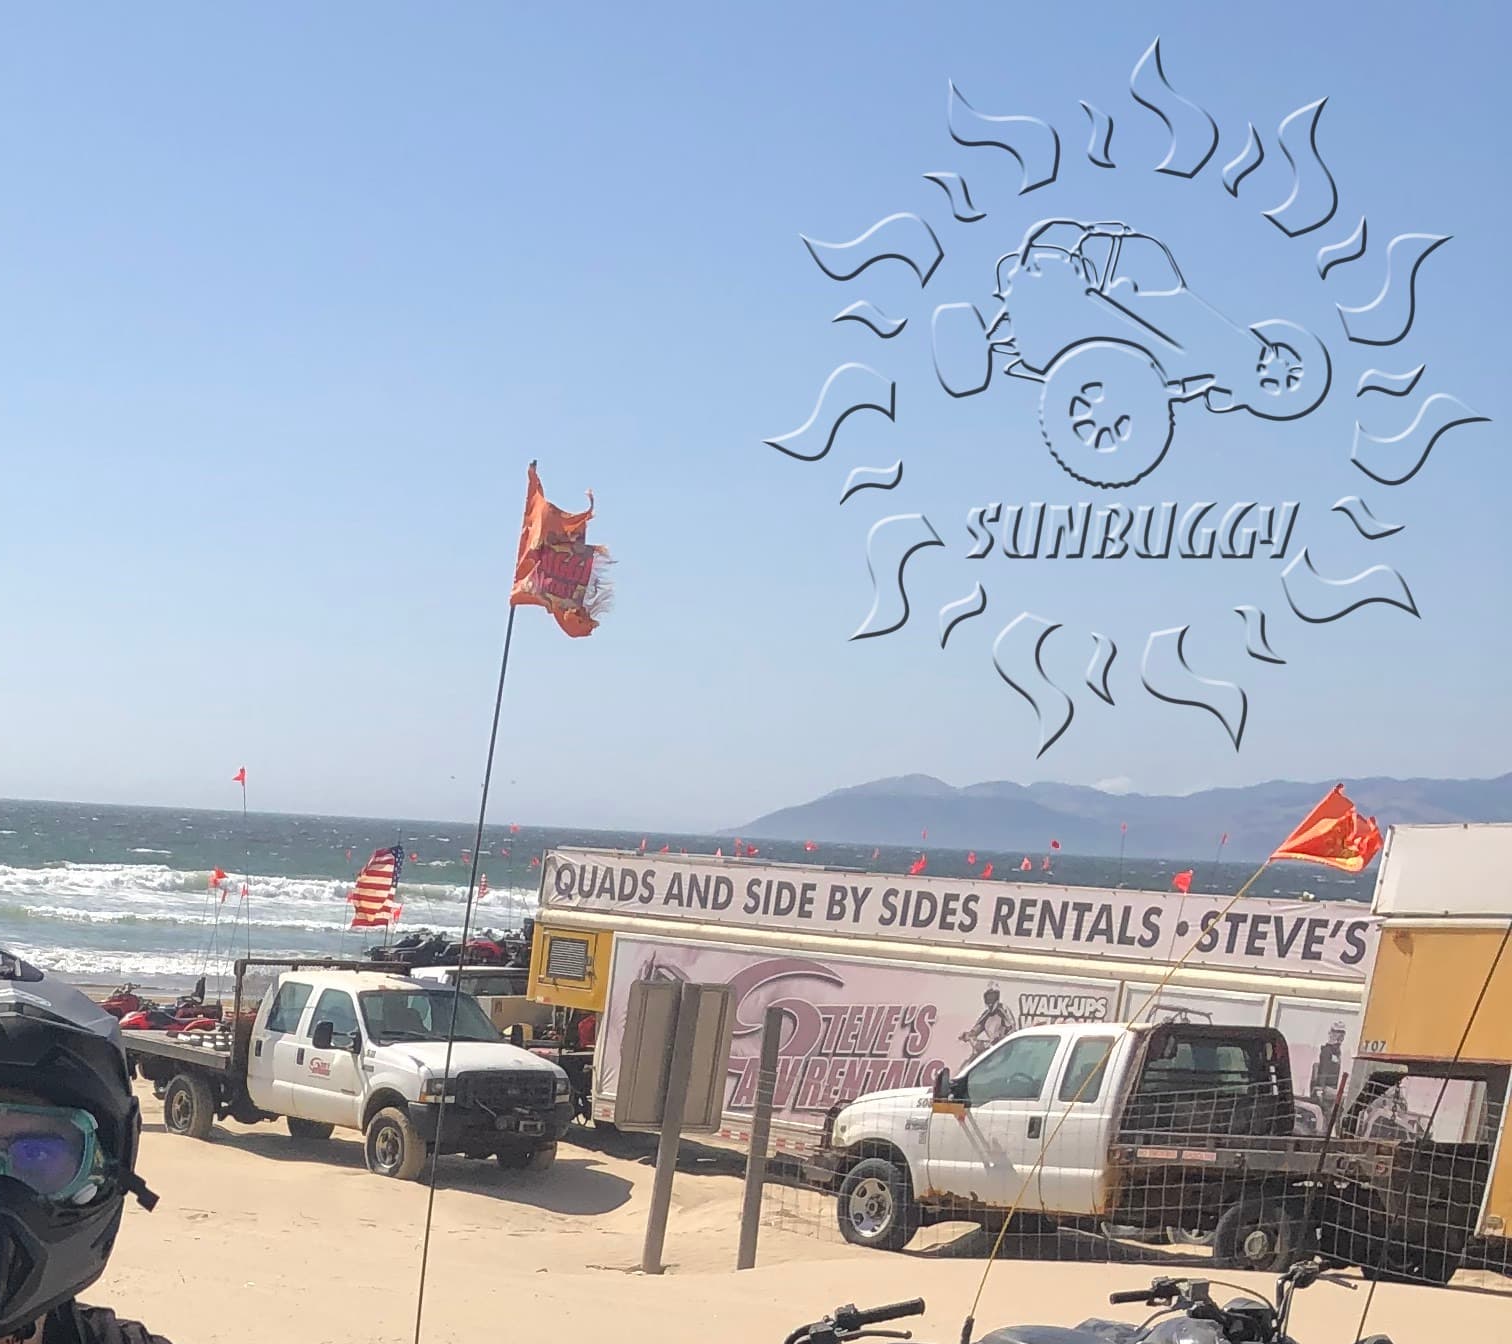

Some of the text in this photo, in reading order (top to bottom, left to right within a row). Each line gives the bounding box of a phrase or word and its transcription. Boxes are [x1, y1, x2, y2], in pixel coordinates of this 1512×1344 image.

[555, 863, 1370, 965] QUADS AND SIDE BY SIDES RENTALS STEVE'S
[731, 957, 938, 1056] STEVE'S
[1019, 993, 1108, 1019] WALK-UPS
[728, 1056, 806, 1107] AV
